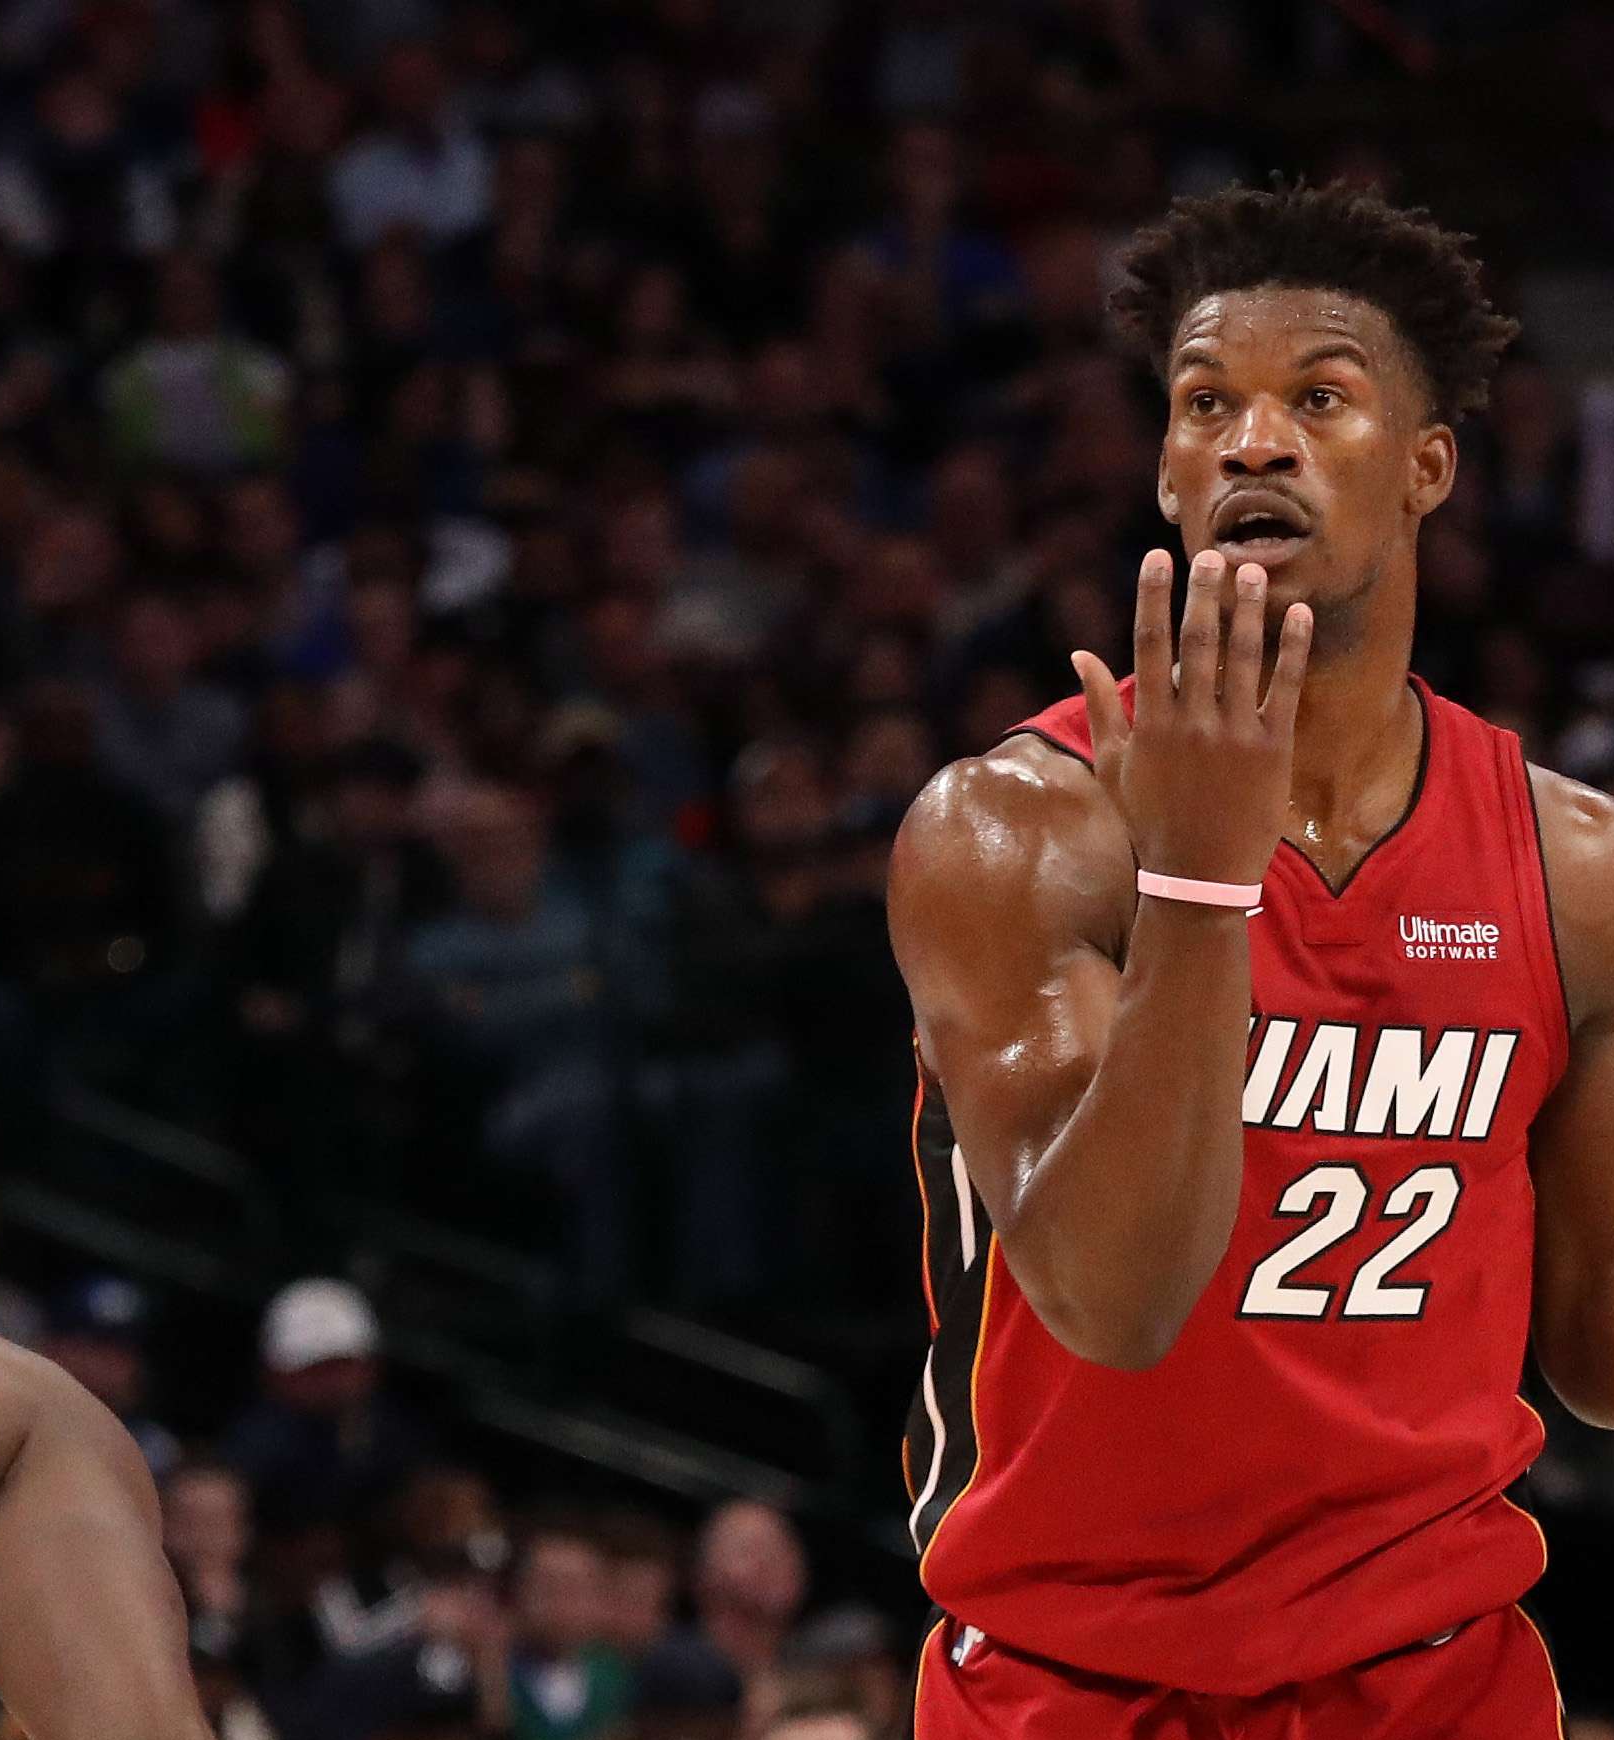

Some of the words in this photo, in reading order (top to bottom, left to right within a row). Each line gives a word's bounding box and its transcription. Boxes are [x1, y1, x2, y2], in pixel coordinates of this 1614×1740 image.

[1399, 915, 1500, 943] Ultimate
[1405, 945, 1498, 959] SOFTWARE
[1242, 1015, 1521, 1142] IAMI
[1237, 1160, 1463, 1322] 22
